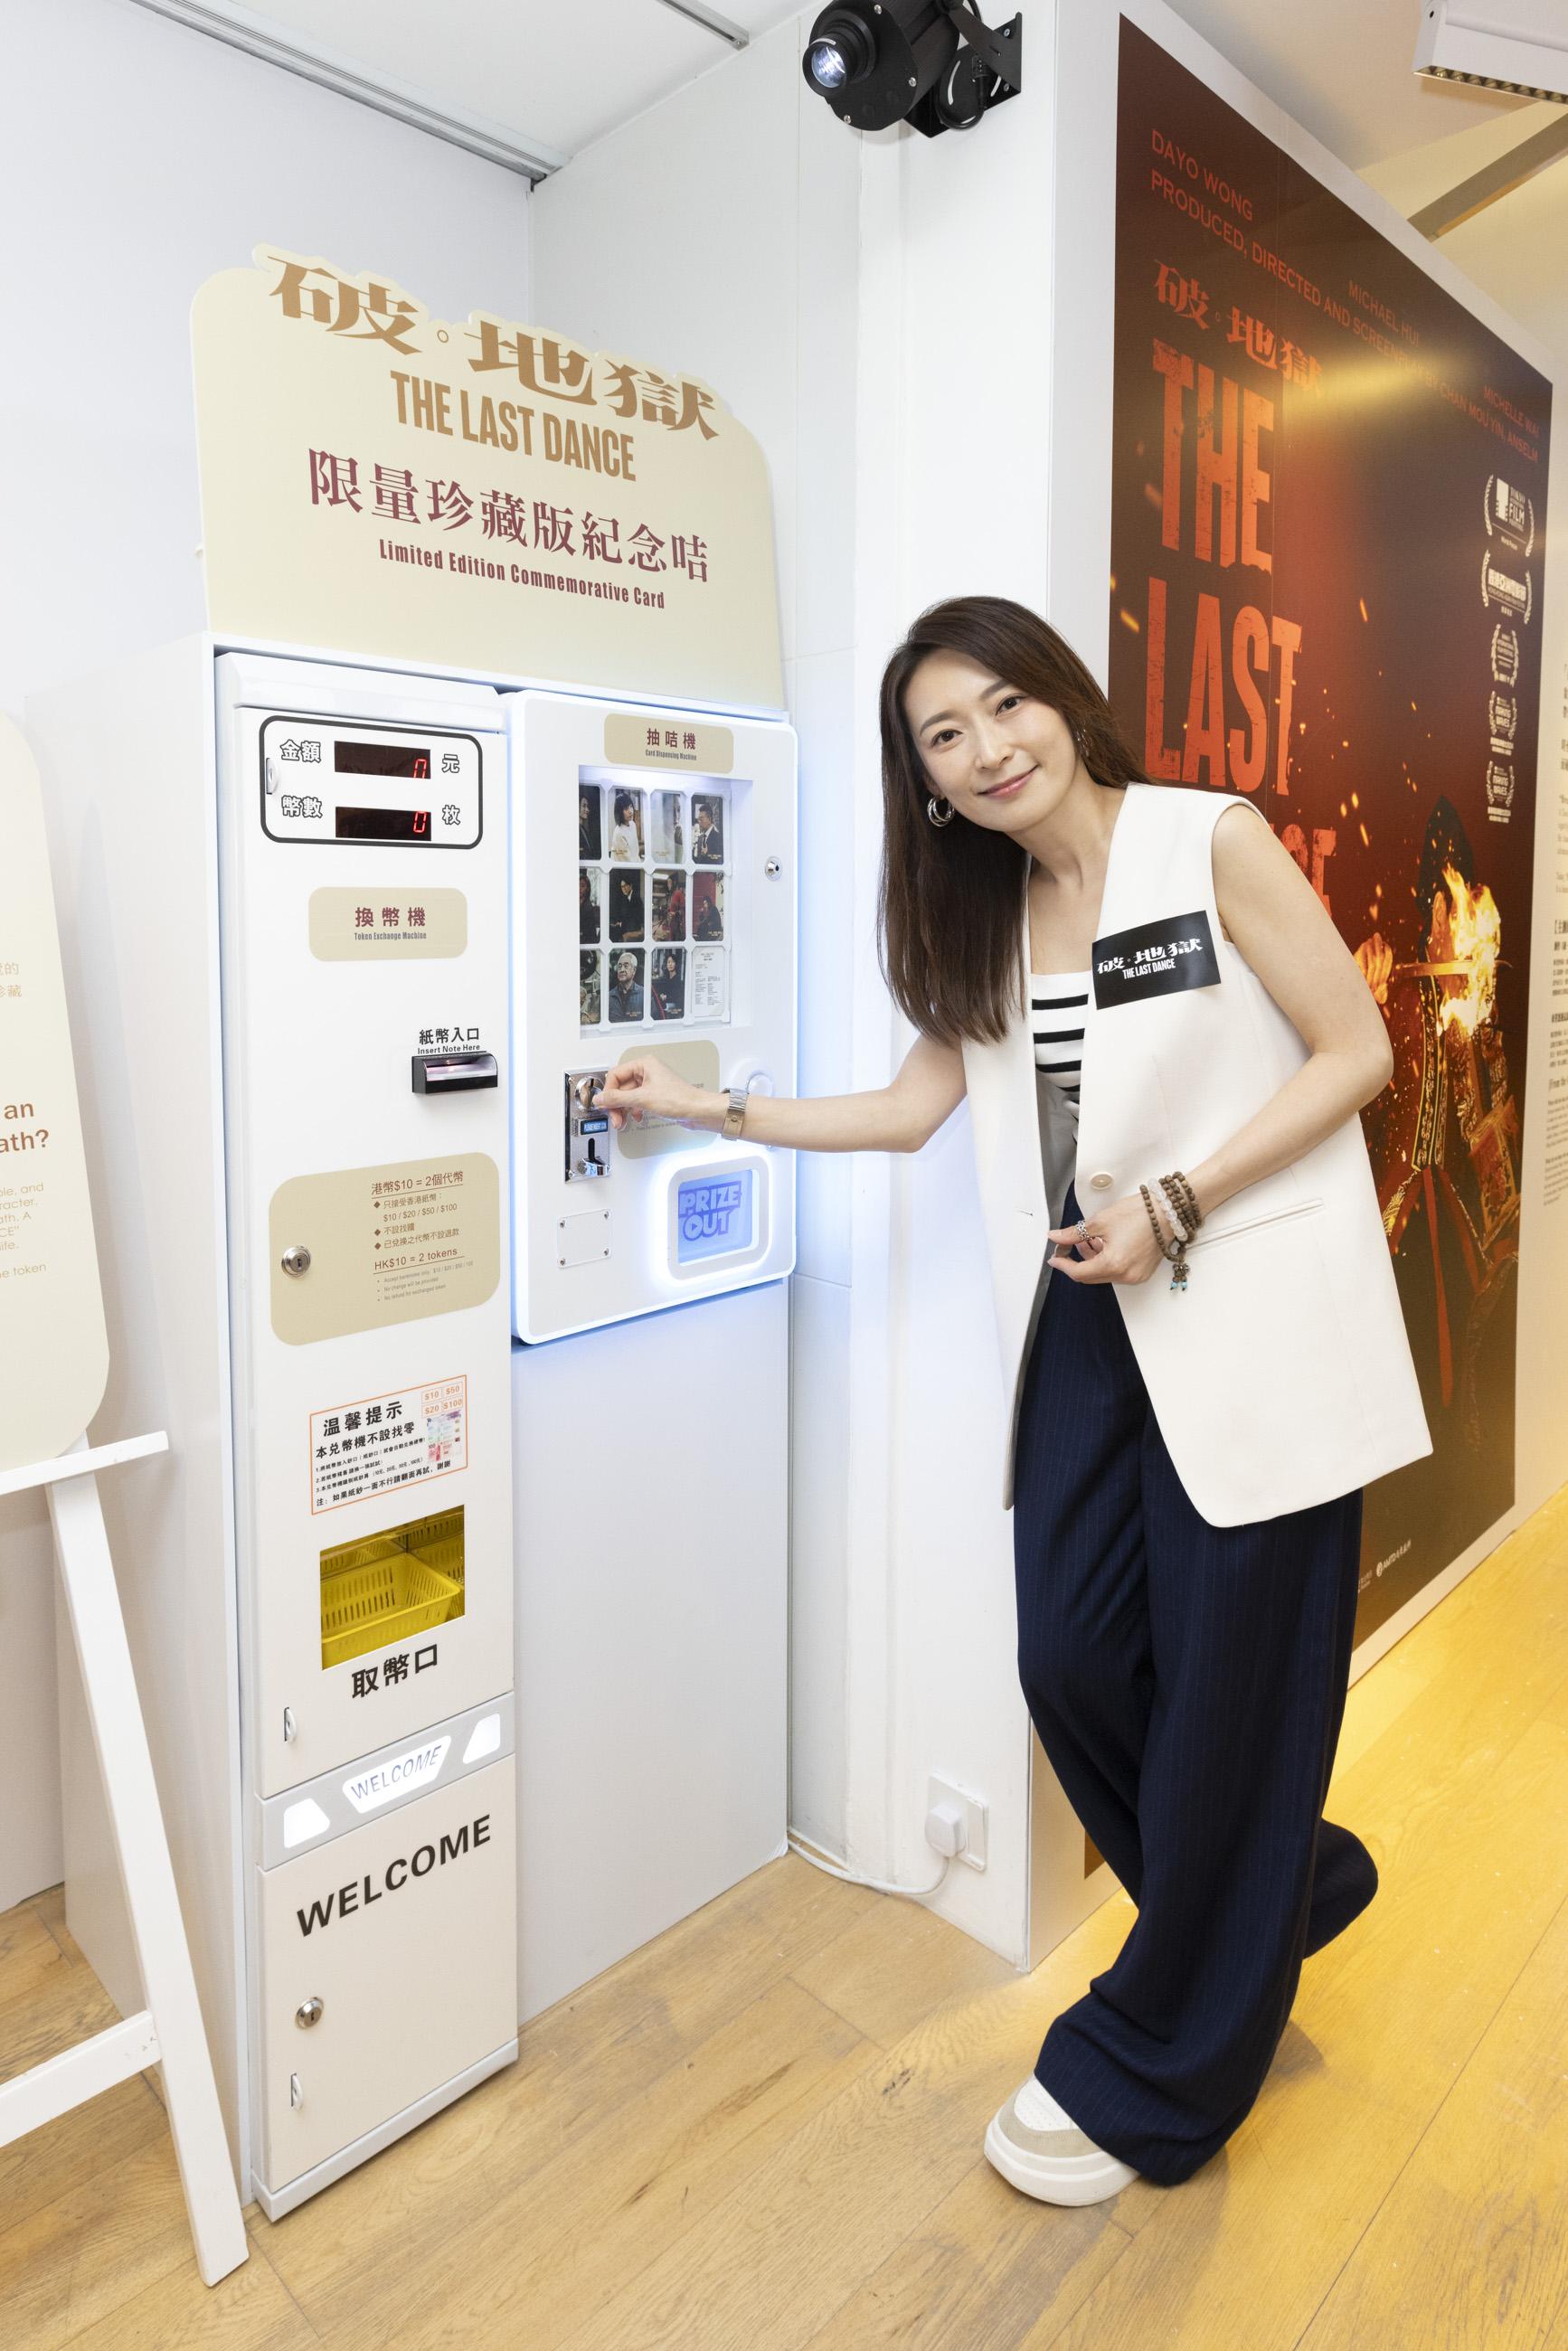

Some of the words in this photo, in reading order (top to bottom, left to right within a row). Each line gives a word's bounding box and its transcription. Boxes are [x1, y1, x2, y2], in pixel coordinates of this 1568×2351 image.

[1152, 129, 1198, 179] DAYO
[1204, 167, 1252, 221] WONG
[1151, 169, 1247, 259] PRODUCED,
[1252, 241, 1320, 307] DIRECTED
[1324, 297, 1350, 327] AND
[1349, 279, 1399, 333] MICHAEL
[1402, 320, 1419, 348] HUI
[390, 370, 453, 436] THE
[460, 390, 534, 456] LAST
[543, 412, 636, 481] DANCE
[1153, 337, 1274, 576] THE
[308, 448, 708, 582] 限量珍藏版紀念咭
[380, 539, 443, 569] Limited
[449, 552, 505, 581] Edition
[511, 564, 629, 603] Commemorative
[634, 587, 666, 609] Card
[1145, 576, 1302, 796] LAST
[647, 728, 696, 750] 抽咭機
[280, 739, 321, 763] 金額
[441, 753, 460, 773] 元
[281, 795, 323, 818] 幣數
[441, 805, 461, 825] 枚
[355, 907, 426, 928] 換幣機
[354, 932, 373, 940] Token
[373, 932, 401, 941] Exchange
[1122, 968, 1136, 979] THE
[1136, 964, 1151, 977] LAST
[1152, 958, 1176, 973] DANCE
[419, 1027, 479, 1045] 紙幣入口
[418, 1046, 441, 1055] Insert
[442, 1044, 461, 1053] Note
[462, 1043, 480, 1052] Here
[4, 1103, 34, 1119] an
[20, 1182, 44, 1194] and
[679, 1182, 740, 1217] PRIZE
[23, 1211, 32, 1221] A
[383, 1213, 397, 1222] $10
[402, 1211, 416, 1219] $20
[421, 1207, 435, 1215] $50
[440, 1204, 458, 1213] $100
[684, 1212, 729, 1241] OUT
[374, 1256, 407, 1270] HK$10
[419, 1253, 425, 1262] 2
[428, 1248, 458, 1260] tokens
[351, 1643, 438, 1699] 取幣口
[351, 1744, 442, 1799] WELCOME
[297, 1814, 491, 1937] WELCOME
